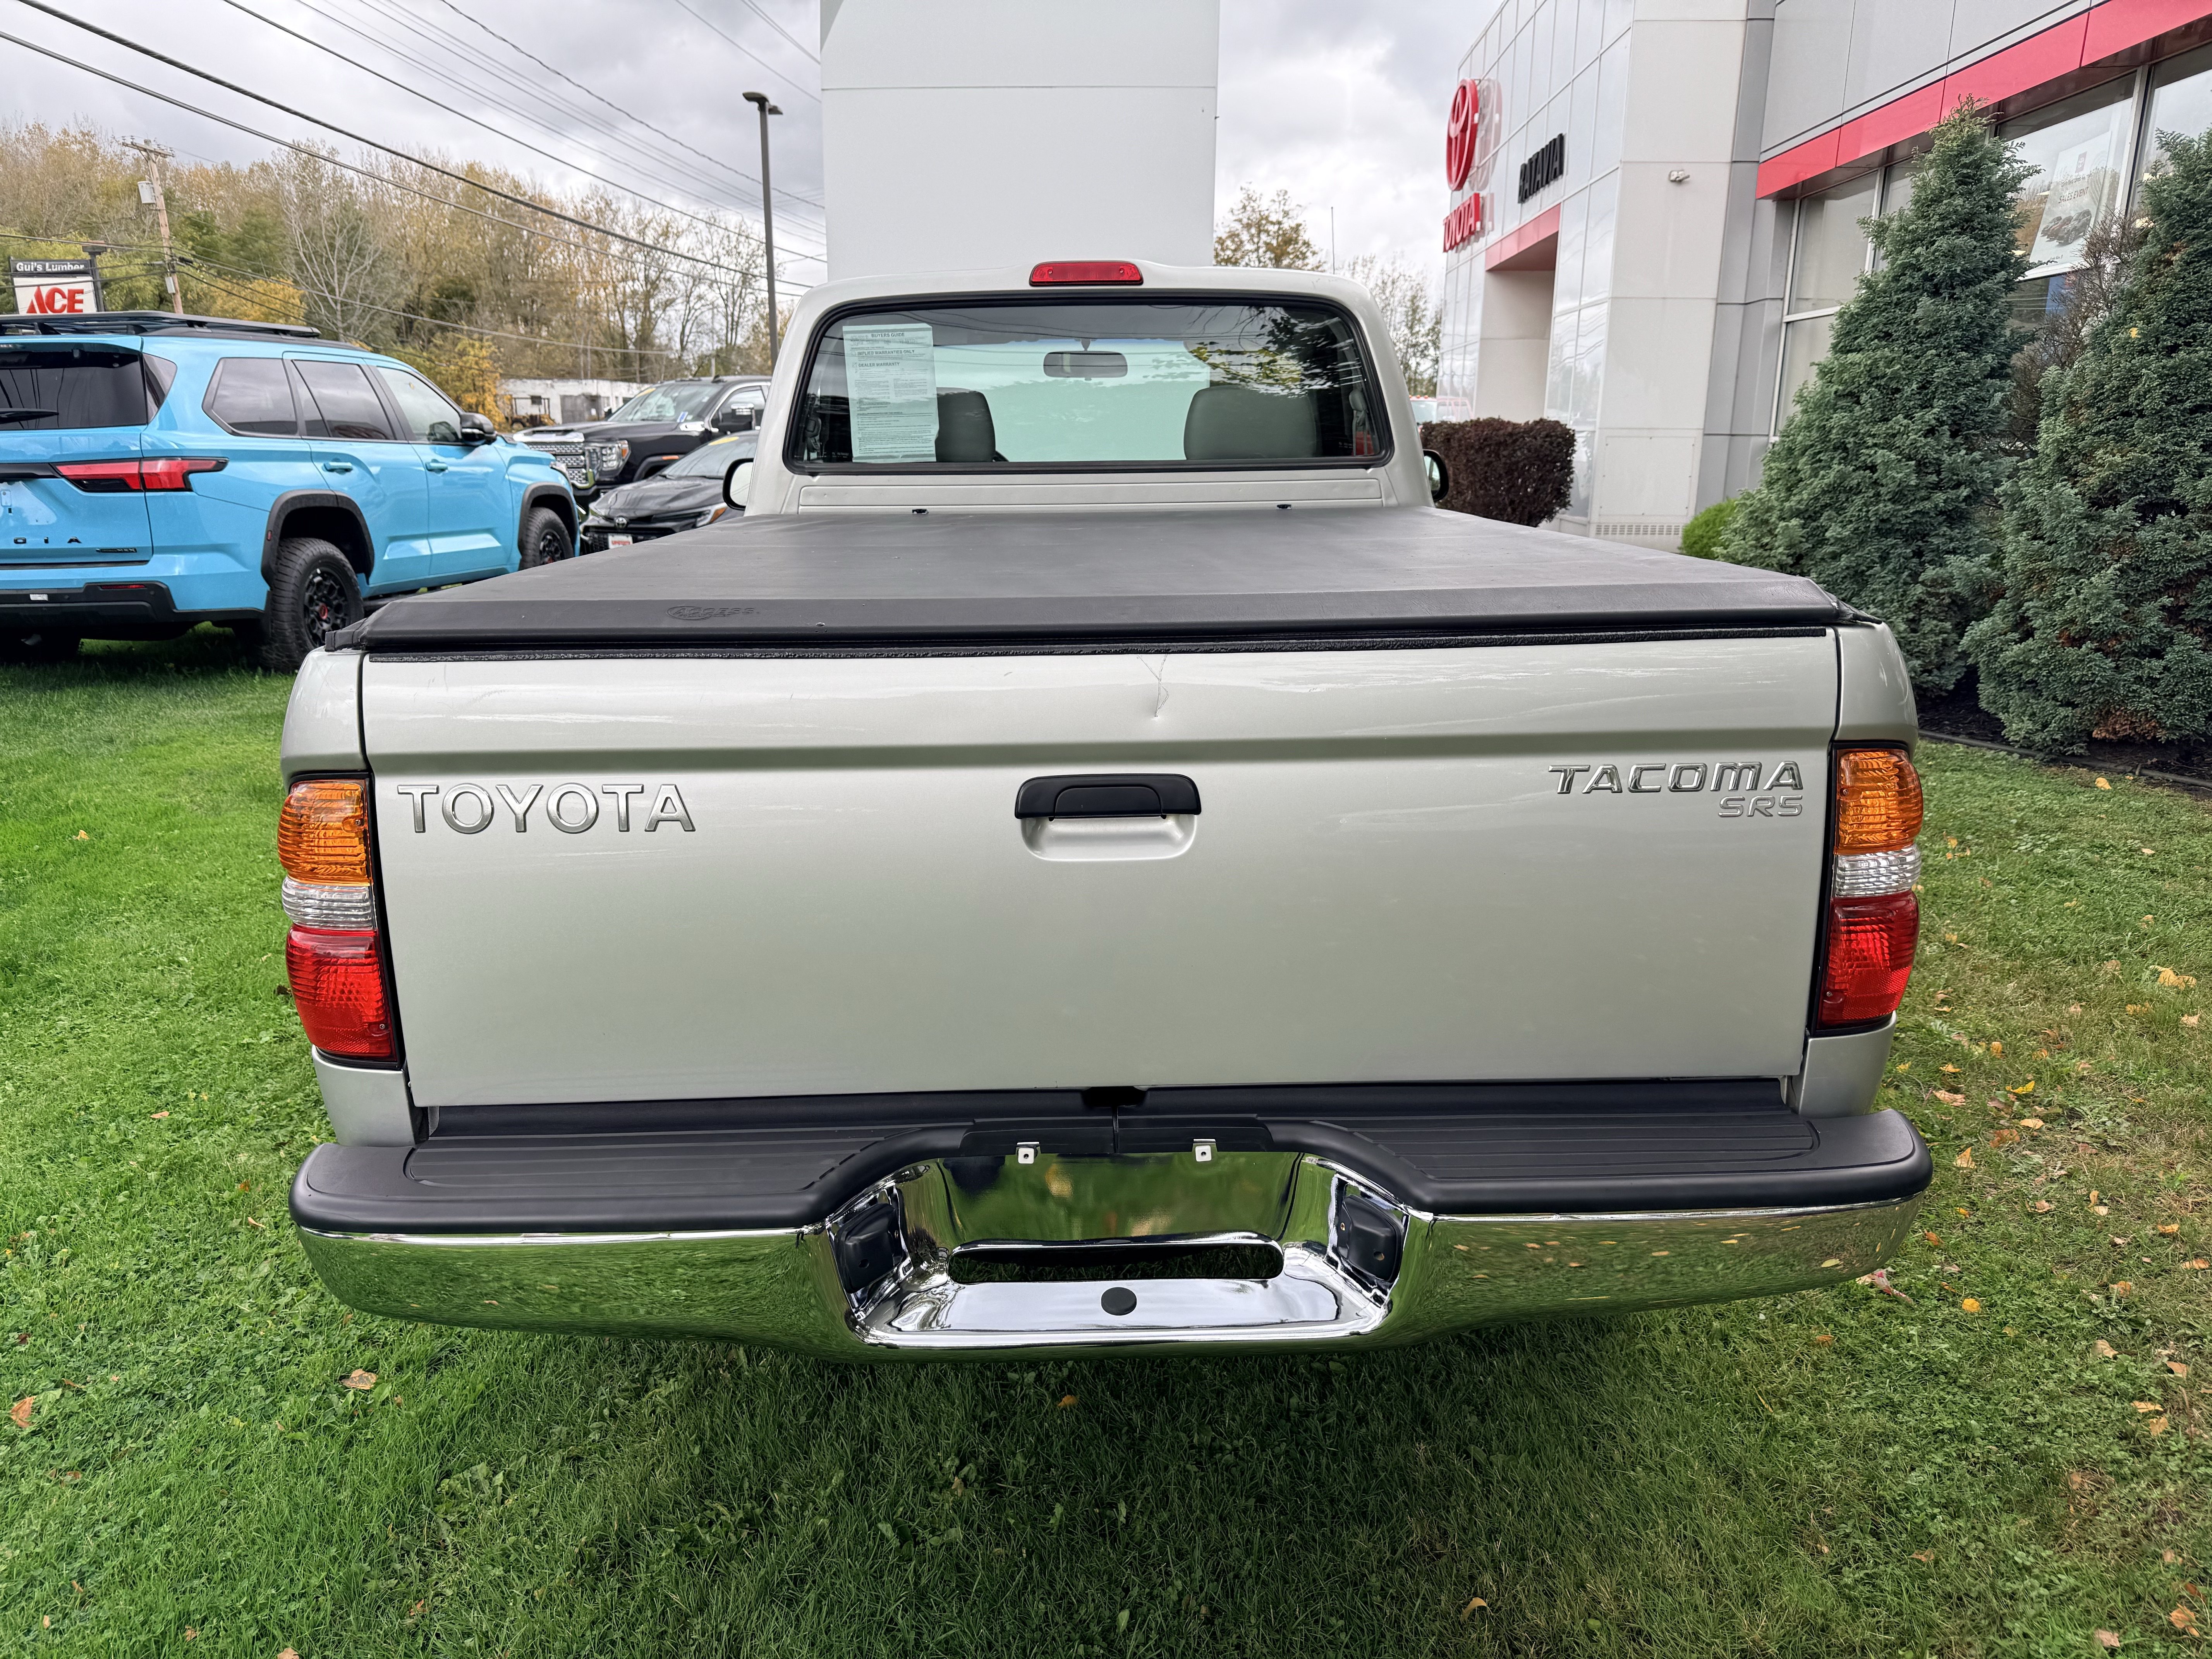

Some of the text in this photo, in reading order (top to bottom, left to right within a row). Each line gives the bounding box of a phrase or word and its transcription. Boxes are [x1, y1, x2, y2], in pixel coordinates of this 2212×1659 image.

[1518, 133, 1566, 204] BATAVIA
[2058, 187, 2089, 203] SALES EVENT
[1443, 193, 1480, 252] TOYOTA
[16, 262, 84, 271] Gui's Lumber
[26, 286, 84, 314] ACE
[673, 608, 757, 617] ACCESS
[1548, 761, 1803, 794] TACOMA
[397, 782, 696, 835] TOYOTA
[1718, 795, 1803, 817] SR5
